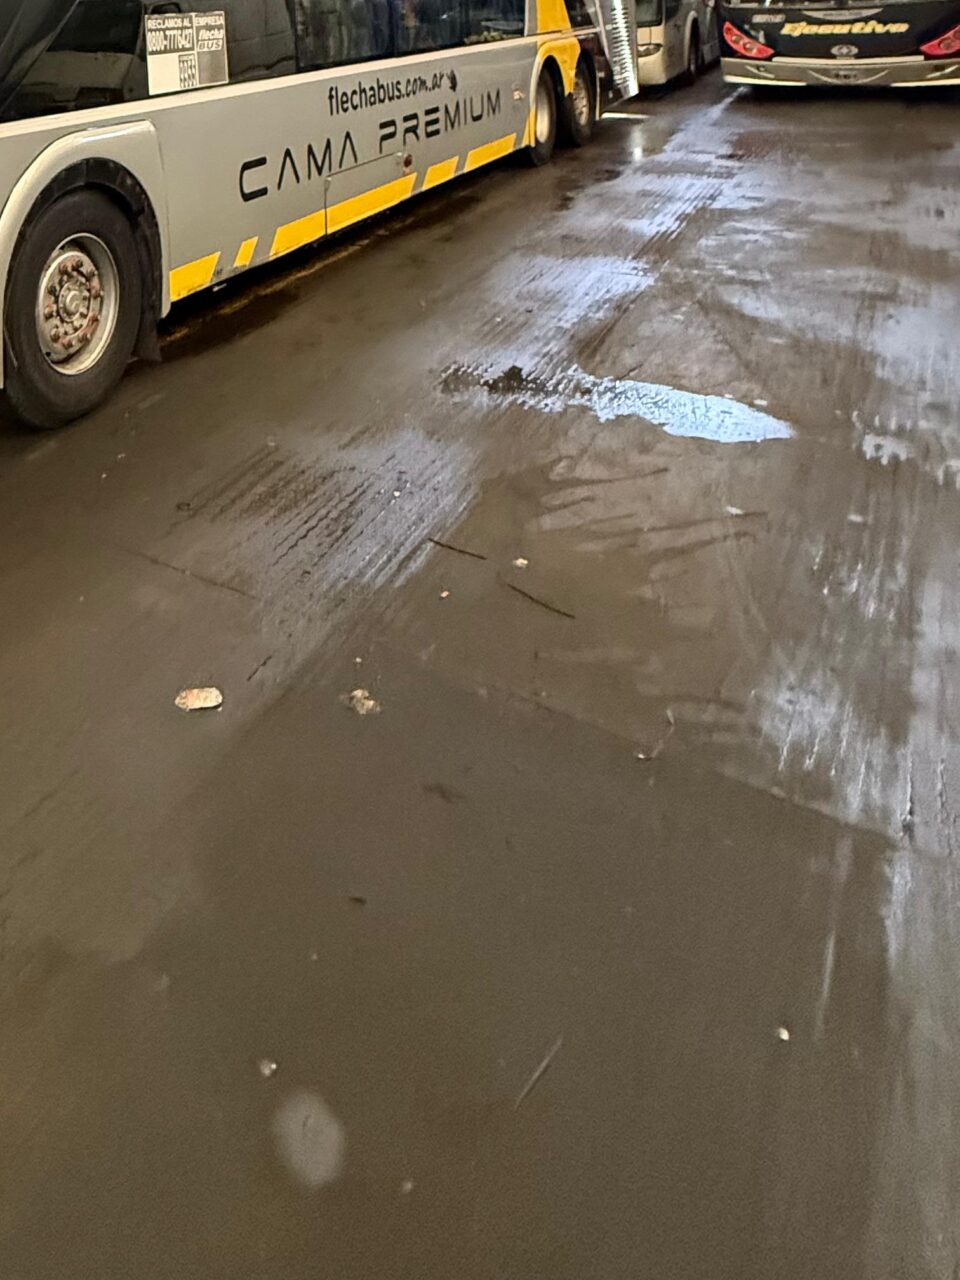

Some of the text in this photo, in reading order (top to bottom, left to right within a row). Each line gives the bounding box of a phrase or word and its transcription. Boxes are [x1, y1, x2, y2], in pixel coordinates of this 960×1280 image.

[147, 17, 191, 29] RECLAMOS AL
[195, 16, 224, 26] EMPRESA
[199, 40, 221, 50] BUS
[328, 72, 444, 116] flechabus.com.ar
[239, 88, 502, 202] CAMA PREMIUM
